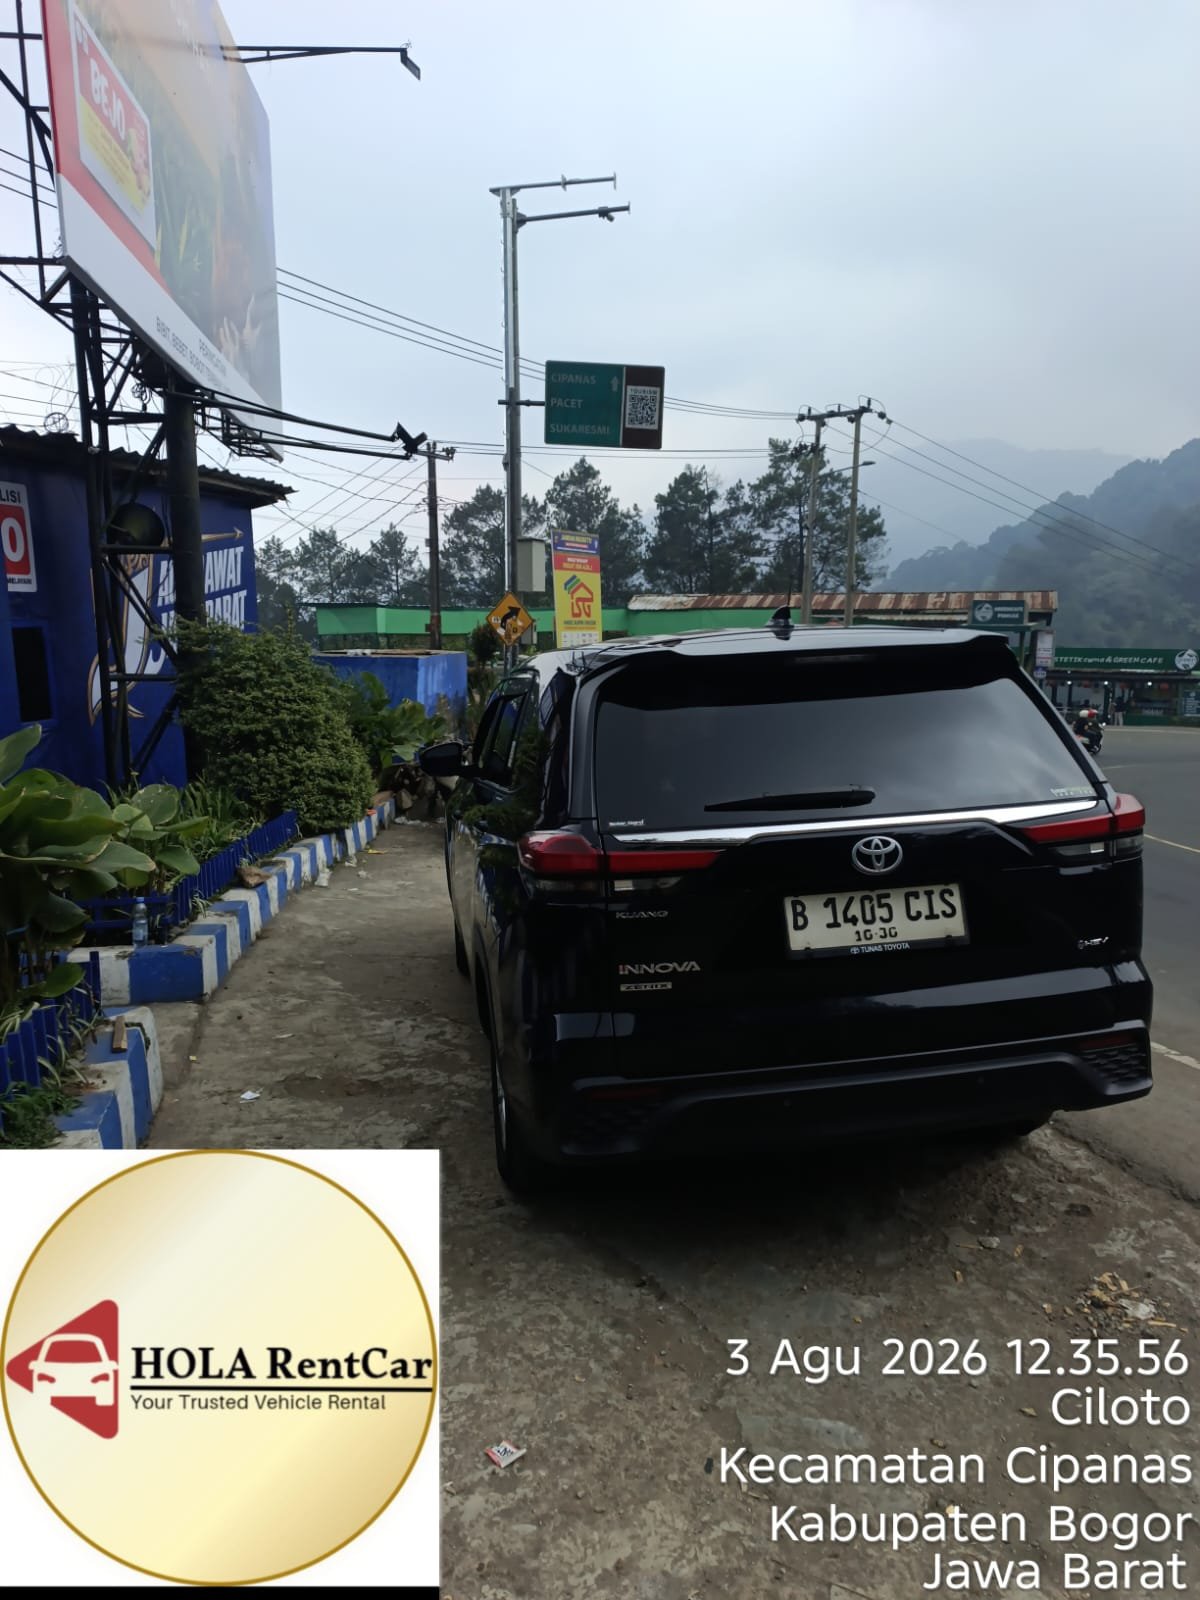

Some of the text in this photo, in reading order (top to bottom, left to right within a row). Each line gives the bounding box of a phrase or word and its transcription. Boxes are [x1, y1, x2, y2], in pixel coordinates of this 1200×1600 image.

[90, 57, 125, 140] BEJO
[551, 373, 597, 385] CIPANAS
[550, 397, 584, 409] PACET
[549, 423, 611, 435] SUKARESMI
[202, 546, 244, 594] AWAT
[1113, 656, 1140, 664] GREEN
[791, 888, 957, 931] B 1405 CIS
[861, 942, 910, 953] TUNAS TOYOTA
[619, 961, 701, 975] INNOVA
